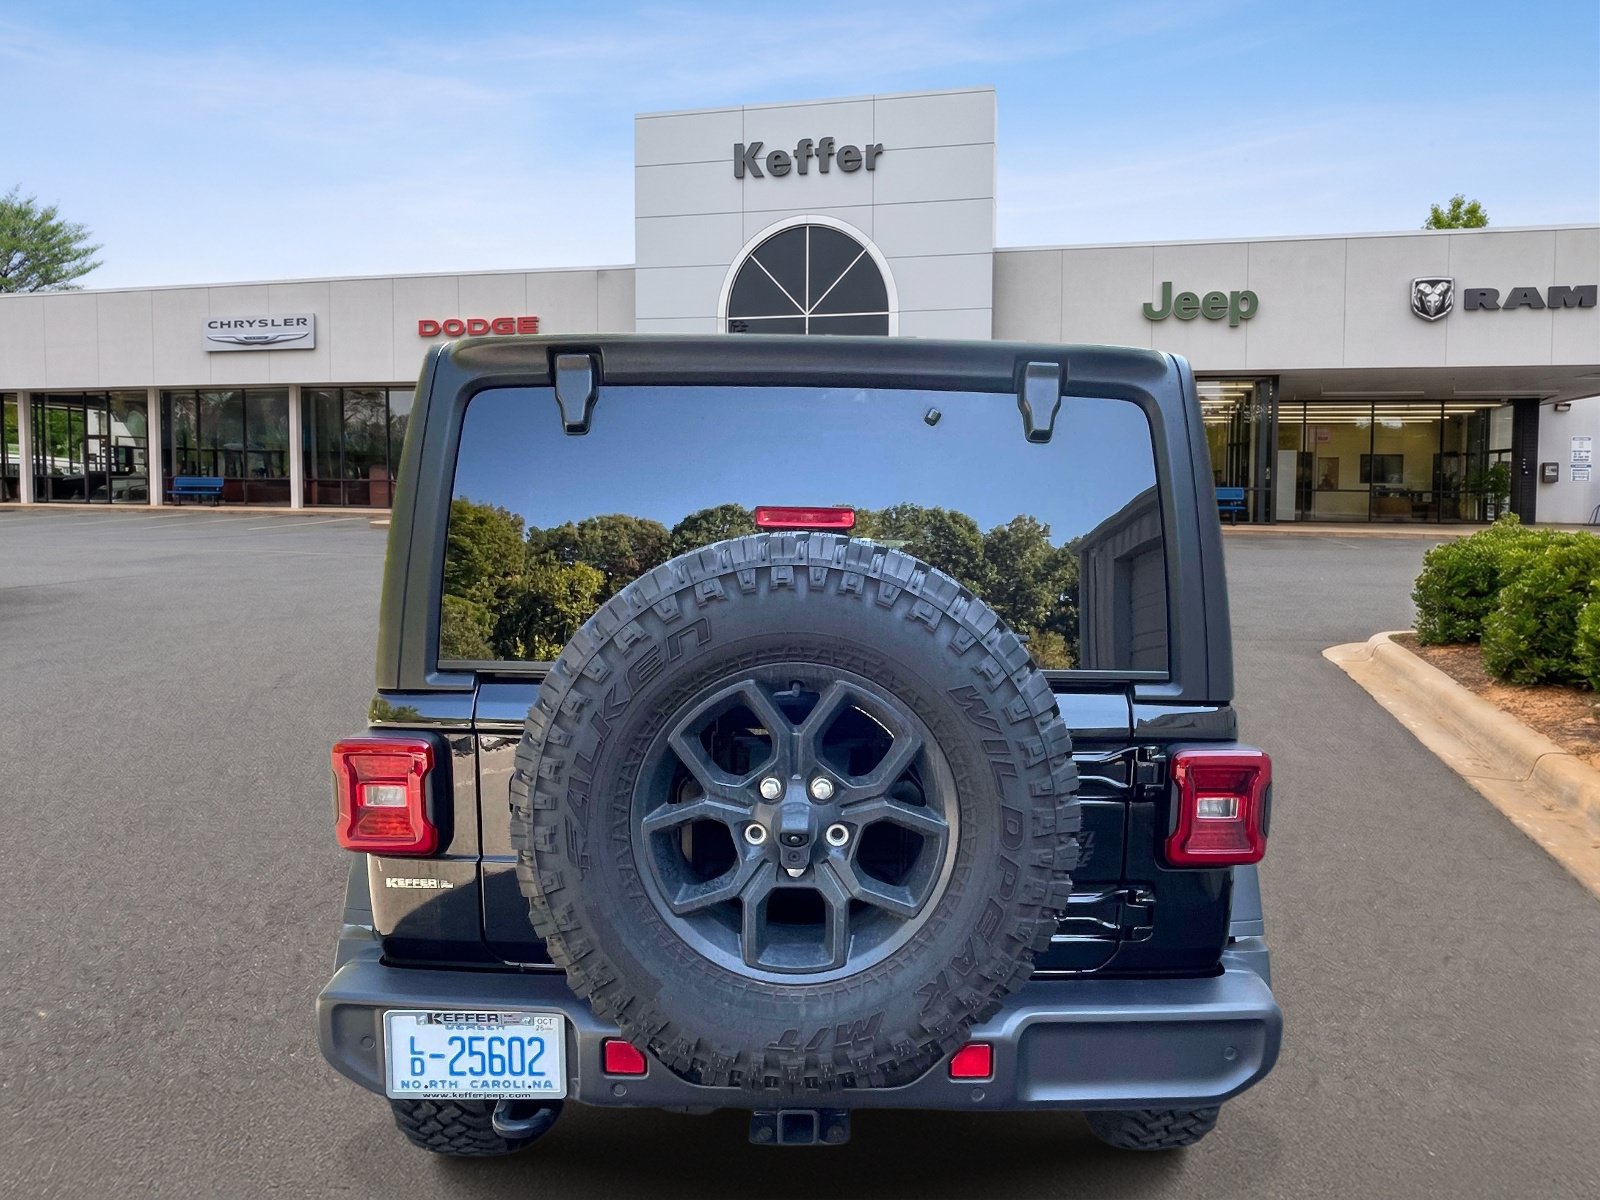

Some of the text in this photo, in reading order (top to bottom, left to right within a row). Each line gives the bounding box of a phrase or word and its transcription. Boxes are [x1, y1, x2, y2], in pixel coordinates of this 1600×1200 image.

[733, 136, 884, 178] Keffer
[1143, 281, 1259, 328] Jeep
[1464, 285, 1598, 311] RAM
[207, 317, 308, 329] CHRYSLER
[418, 316, 539, 338] DODGE
[385, 877, 438, 889] KEFFER
[427, 1012, 499, 1025] KEFFER
[401, 1080, 553, 1089] NORTH CAROLINA
[422, 1091, 531, 1099] www.kefferjeep.com
